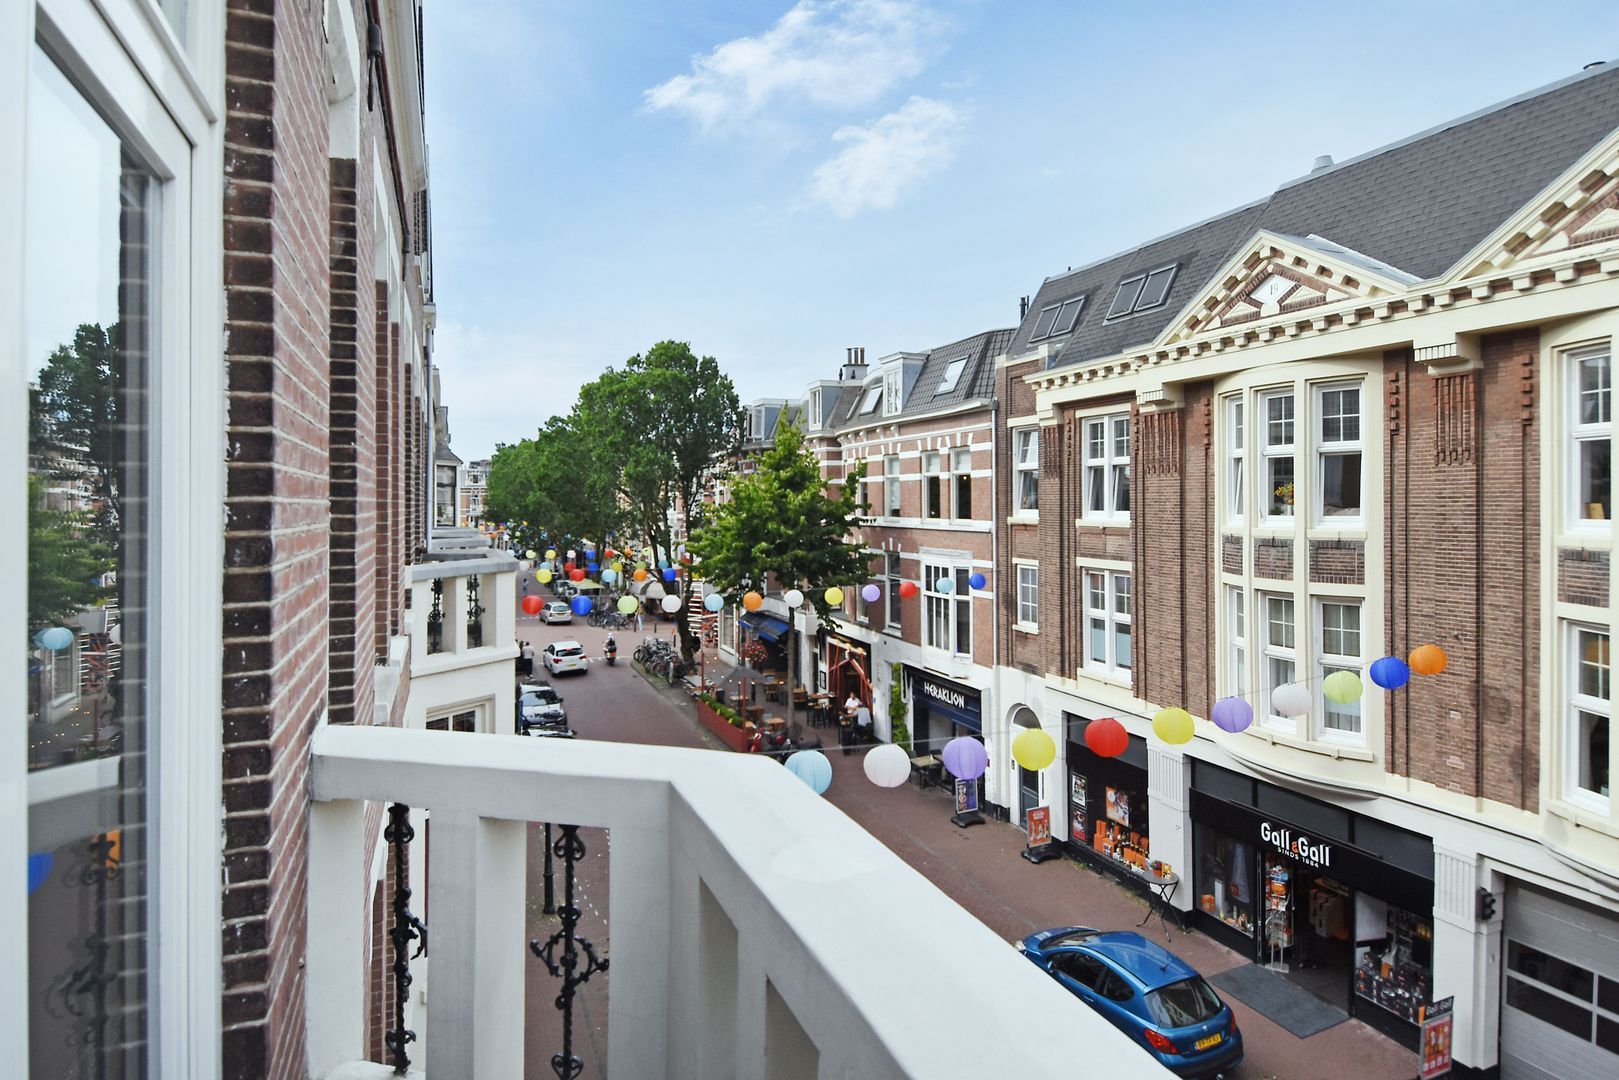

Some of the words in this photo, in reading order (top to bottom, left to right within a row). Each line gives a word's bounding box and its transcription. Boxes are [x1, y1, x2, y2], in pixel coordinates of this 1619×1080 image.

[923, 681, 965, 709] HERAKLION
[1260, 822, 1290, 851] Gall
[1298, 836, 1330, 867] Gall
[1277, 846, 1299, 860] SINDS
